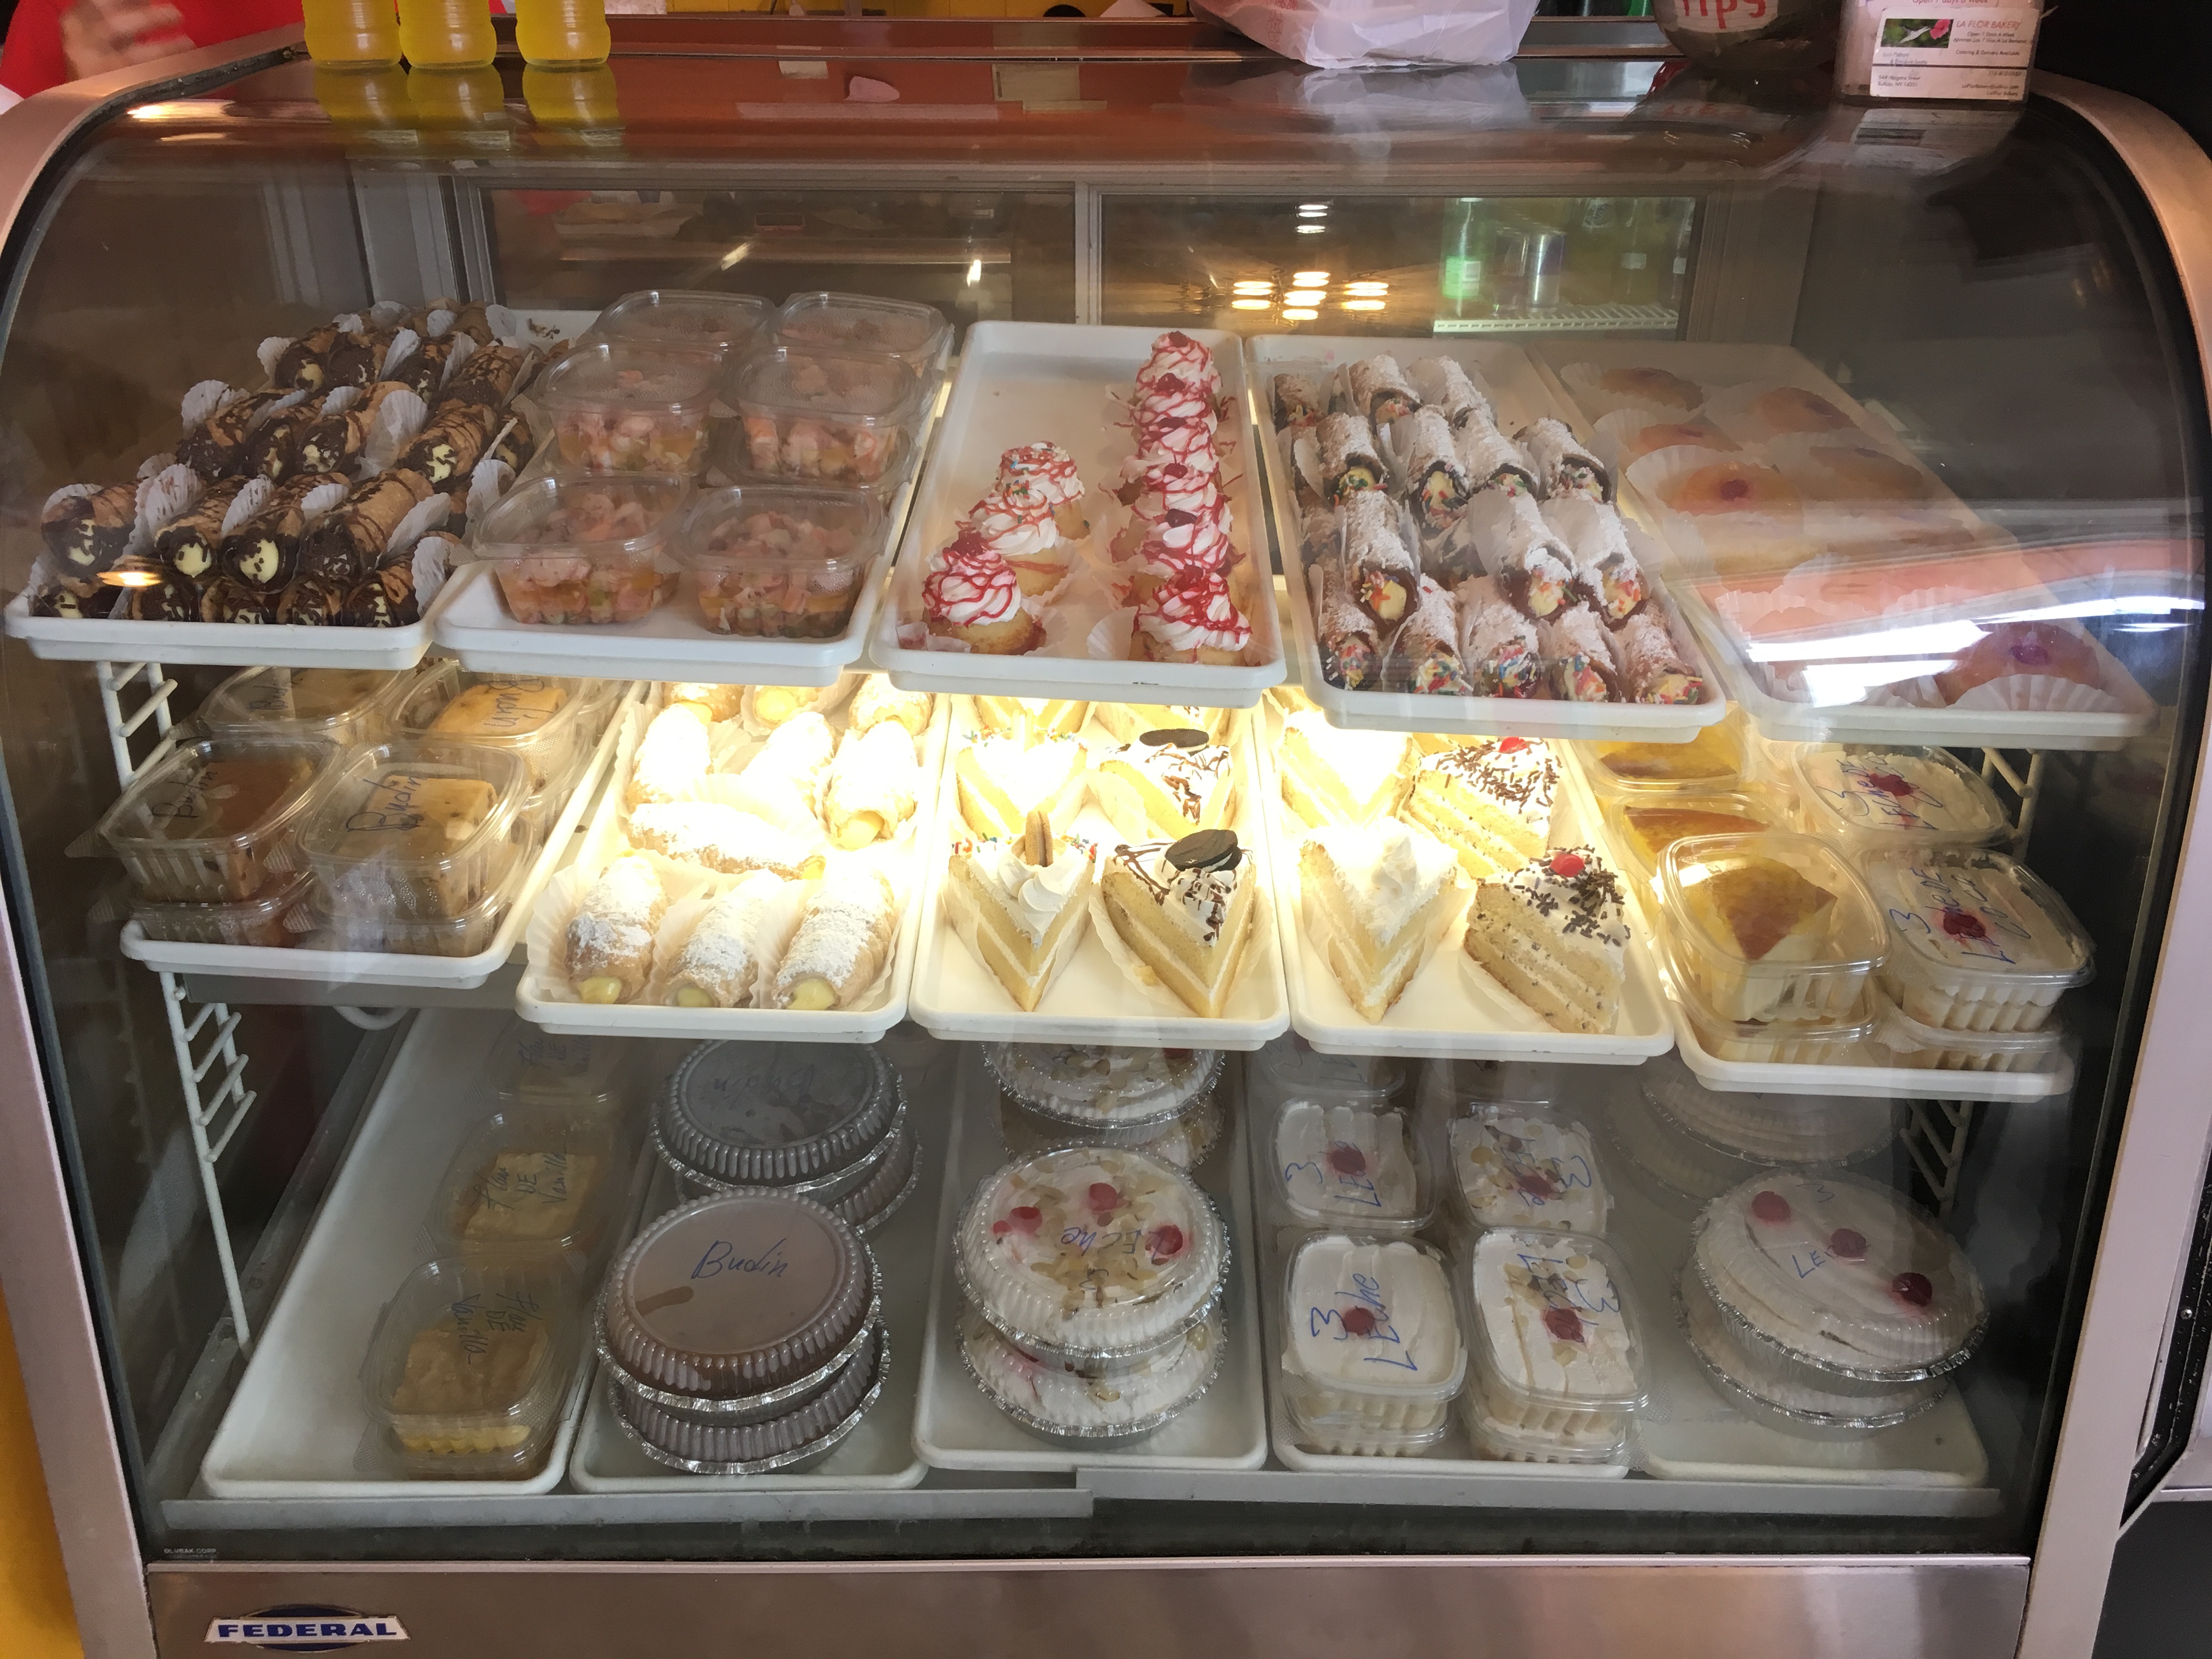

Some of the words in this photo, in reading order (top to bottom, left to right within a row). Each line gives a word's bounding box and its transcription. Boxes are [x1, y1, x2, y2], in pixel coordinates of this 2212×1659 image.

[1968, 20, 1989, 29] FLOR
[1991, 21, 2022, 30] BAKERY
[1889, 909, 1931, 934] 3
[1285, 1161, 1323, 1184] 3
[1310, 1306, 1348, 1341] 3
[217, 1622, 397, 1638] FEDERAL
